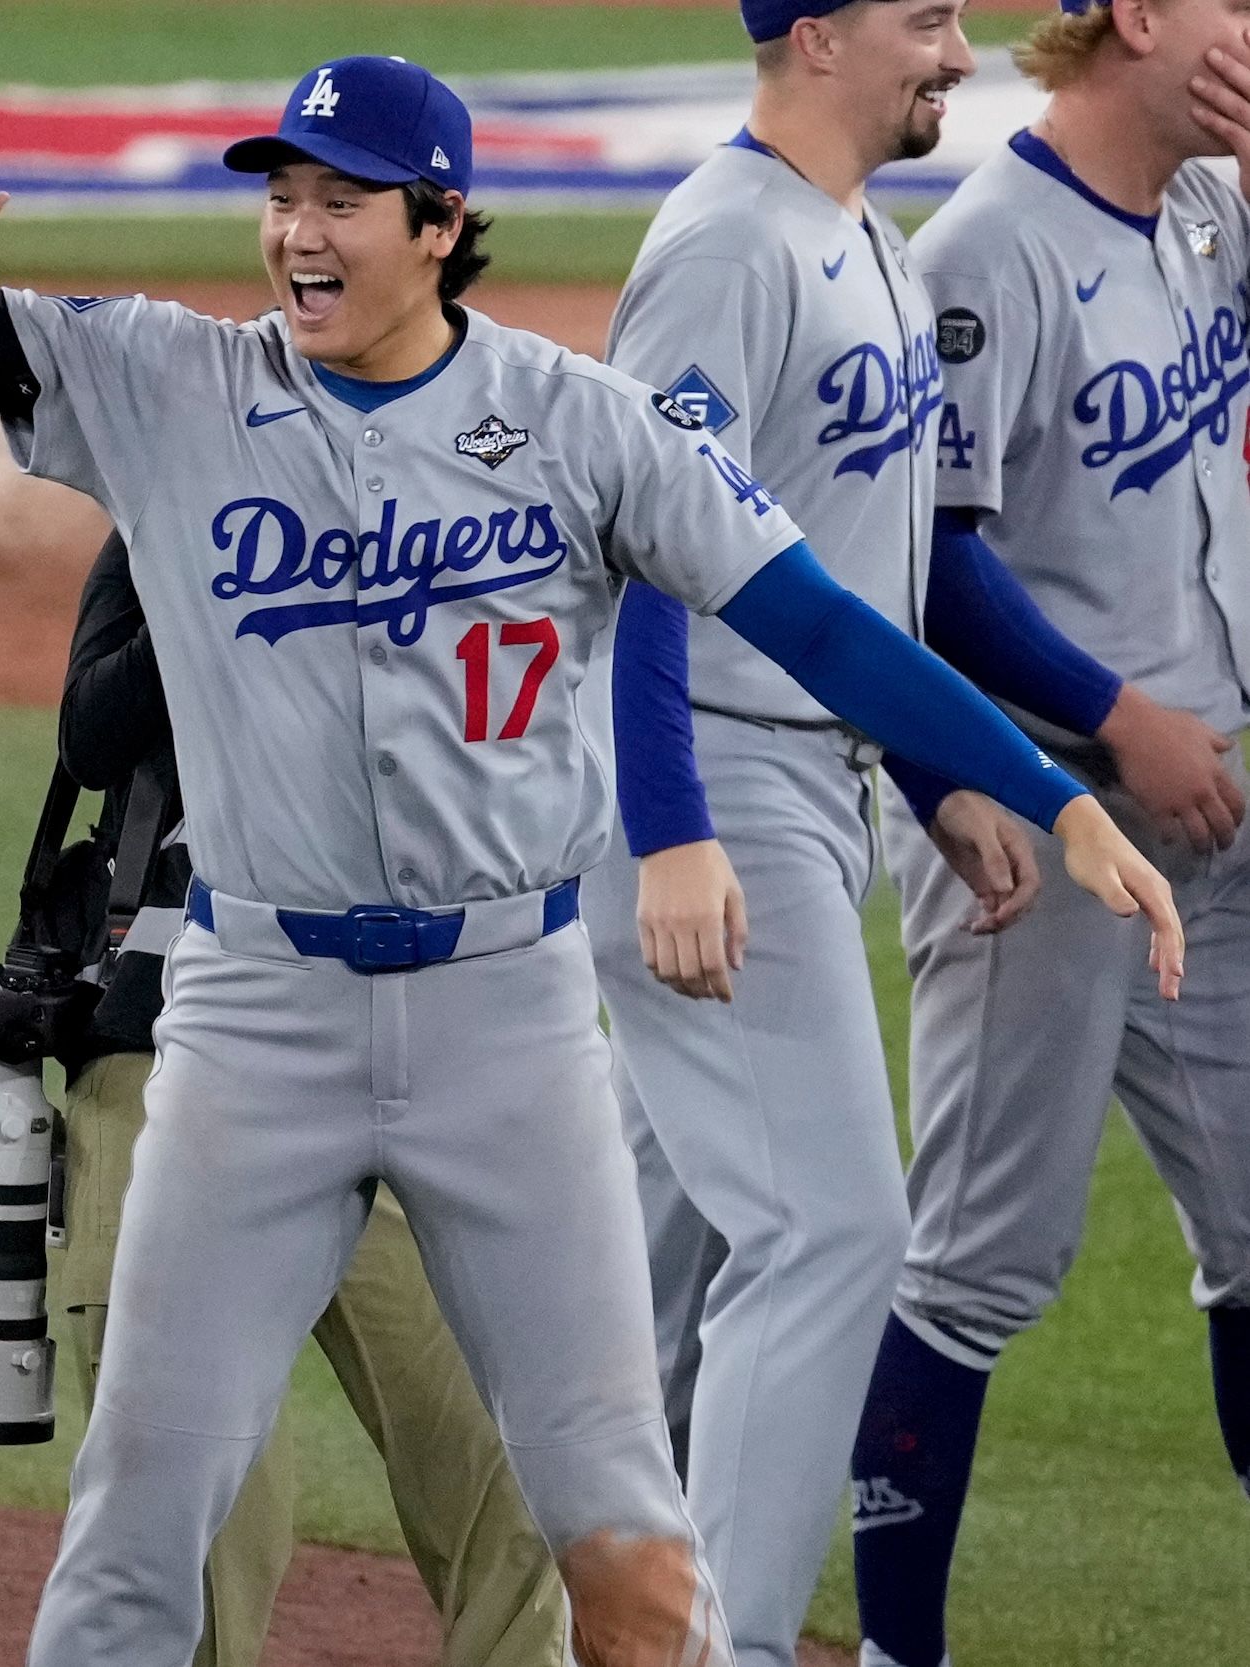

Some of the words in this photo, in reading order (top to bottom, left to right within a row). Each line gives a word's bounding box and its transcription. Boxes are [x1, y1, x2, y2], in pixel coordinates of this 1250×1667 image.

[301, 68, 341, 117] LA
[697, 443, 780, 517] LA
[211, 496, 568, 647] Dodgers
[455, 617, 560, 743] 17
